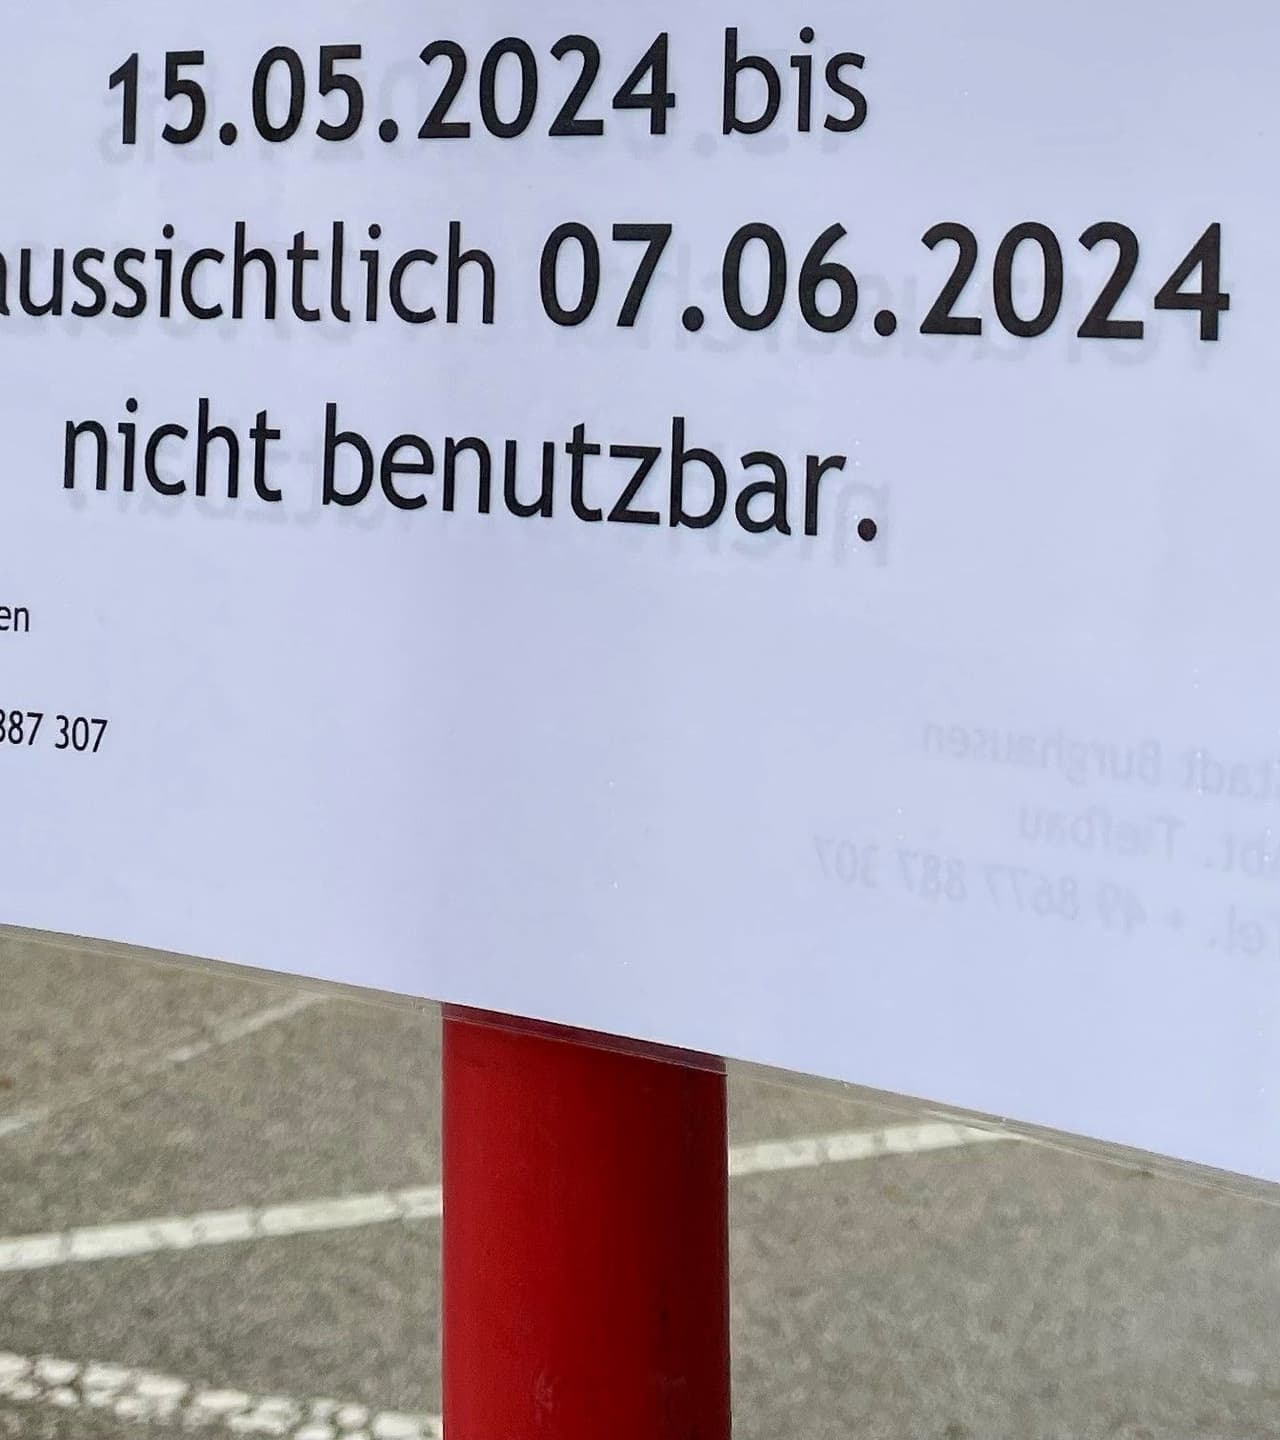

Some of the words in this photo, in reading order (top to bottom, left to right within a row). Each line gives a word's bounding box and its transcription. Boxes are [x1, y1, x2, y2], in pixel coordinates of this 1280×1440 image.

[108, 34, 676, 147] 15.05.2024
[722, 26, 868, 137] bis
[539, 220, 1231, 342] 07.06.2024
[63, 397, 283, 503] nicht
[322, 402, 878, 543] benutzbar.
[54, 714, 110, 753] 307
